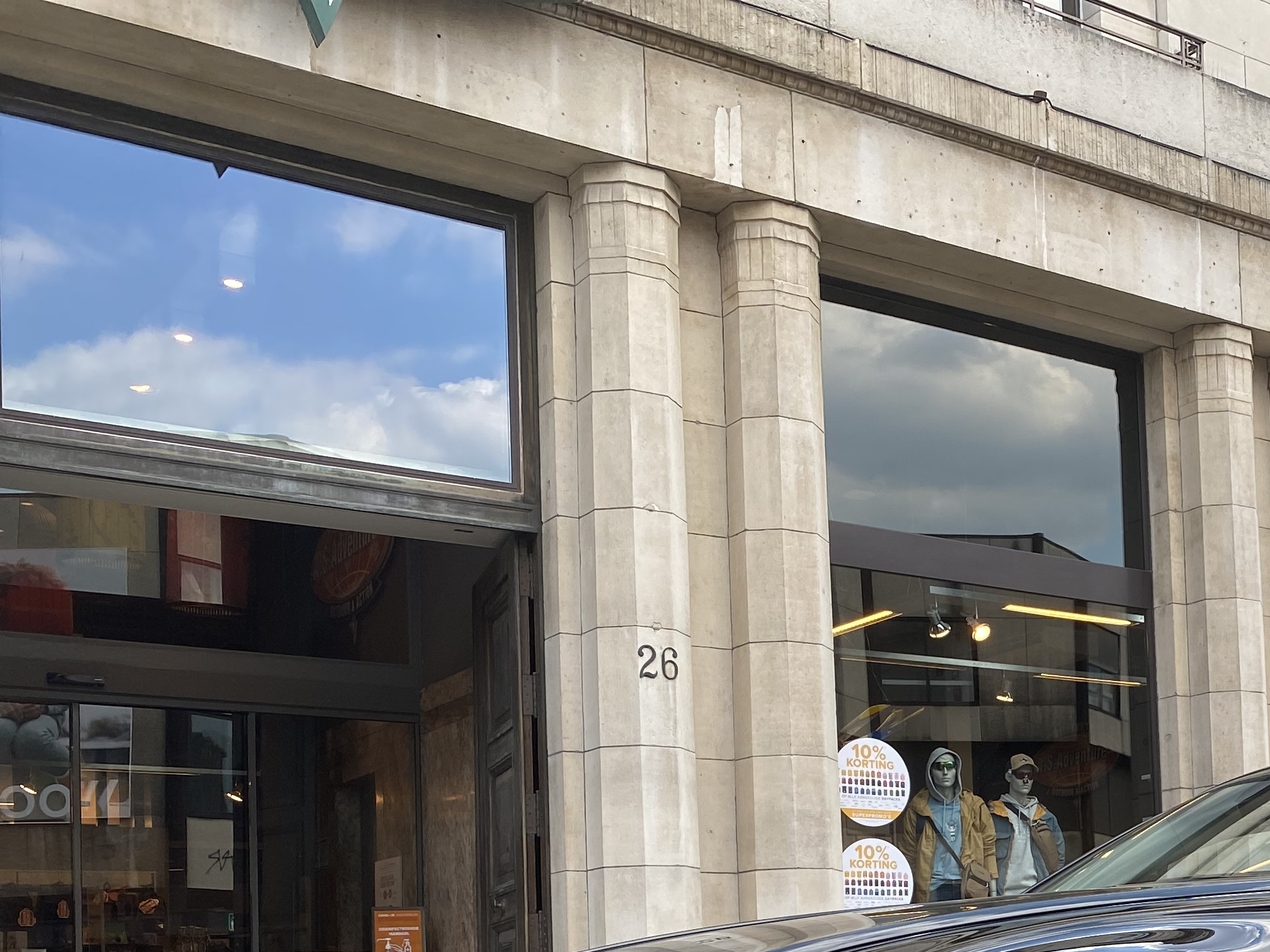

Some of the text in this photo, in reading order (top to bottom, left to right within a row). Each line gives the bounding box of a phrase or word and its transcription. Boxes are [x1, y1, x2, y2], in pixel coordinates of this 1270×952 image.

[637, 644, 679, 680] 26
[851, 743, 887, 761] 10%
[846, 758, 895, 770] KORTING
[854, 844, 890, 861] 10%
[850, 859, 898, 870] KORTING
